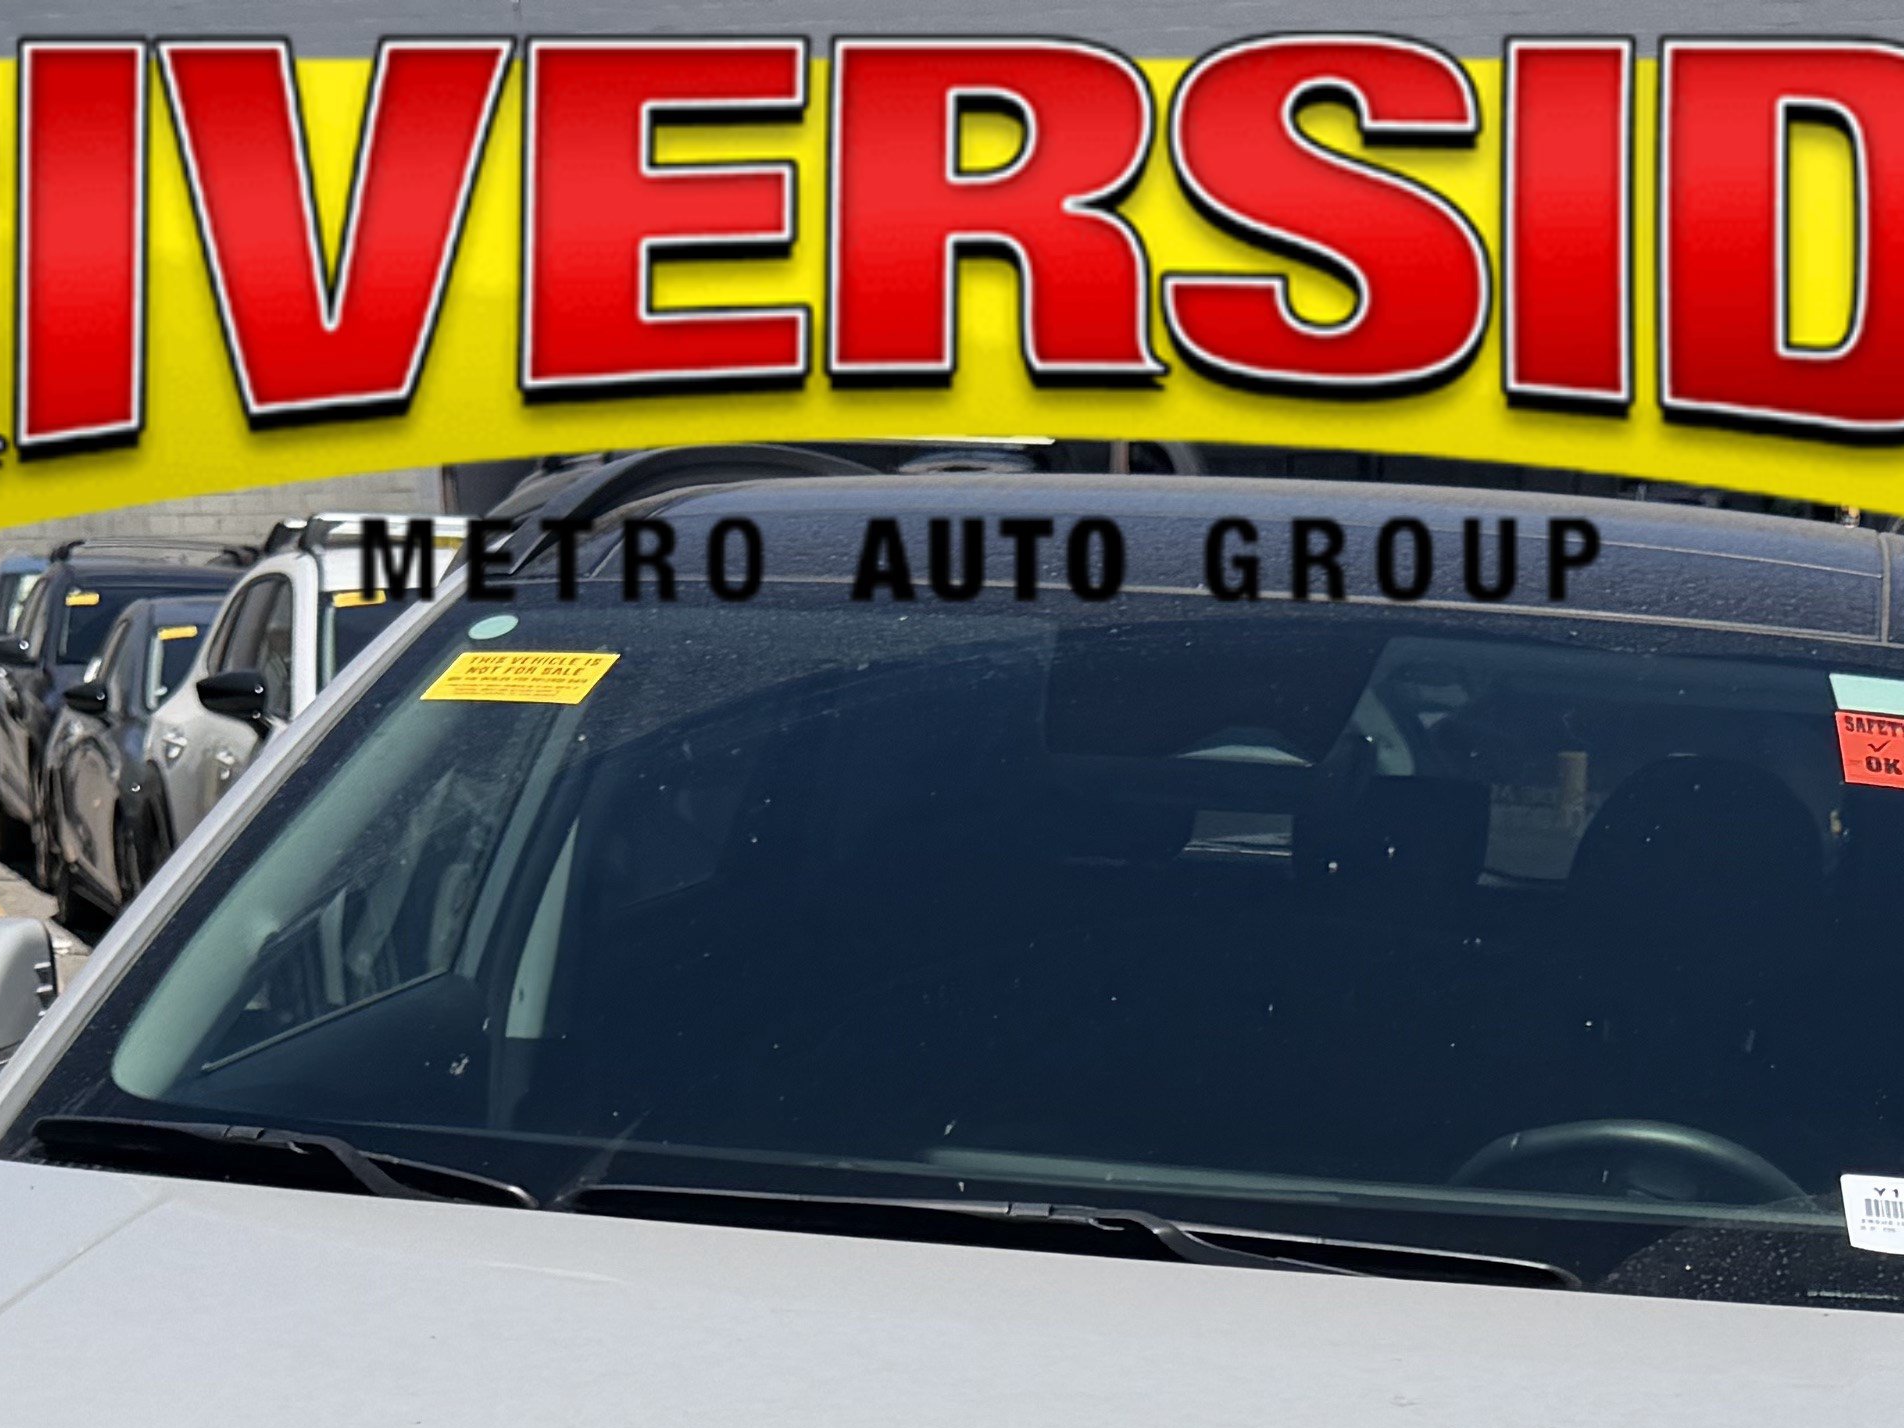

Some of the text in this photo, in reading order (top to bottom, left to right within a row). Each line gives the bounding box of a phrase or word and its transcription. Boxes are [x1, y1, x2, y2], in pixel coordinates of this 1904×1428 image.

[469, 656, 505, 665] THIS
[510, 656, 581, 666] VEHICLE
[464, 666, 501, 675] NOT
[540, 667, 587, 677] SALE
[1864, 755, 1903, 776] OK
